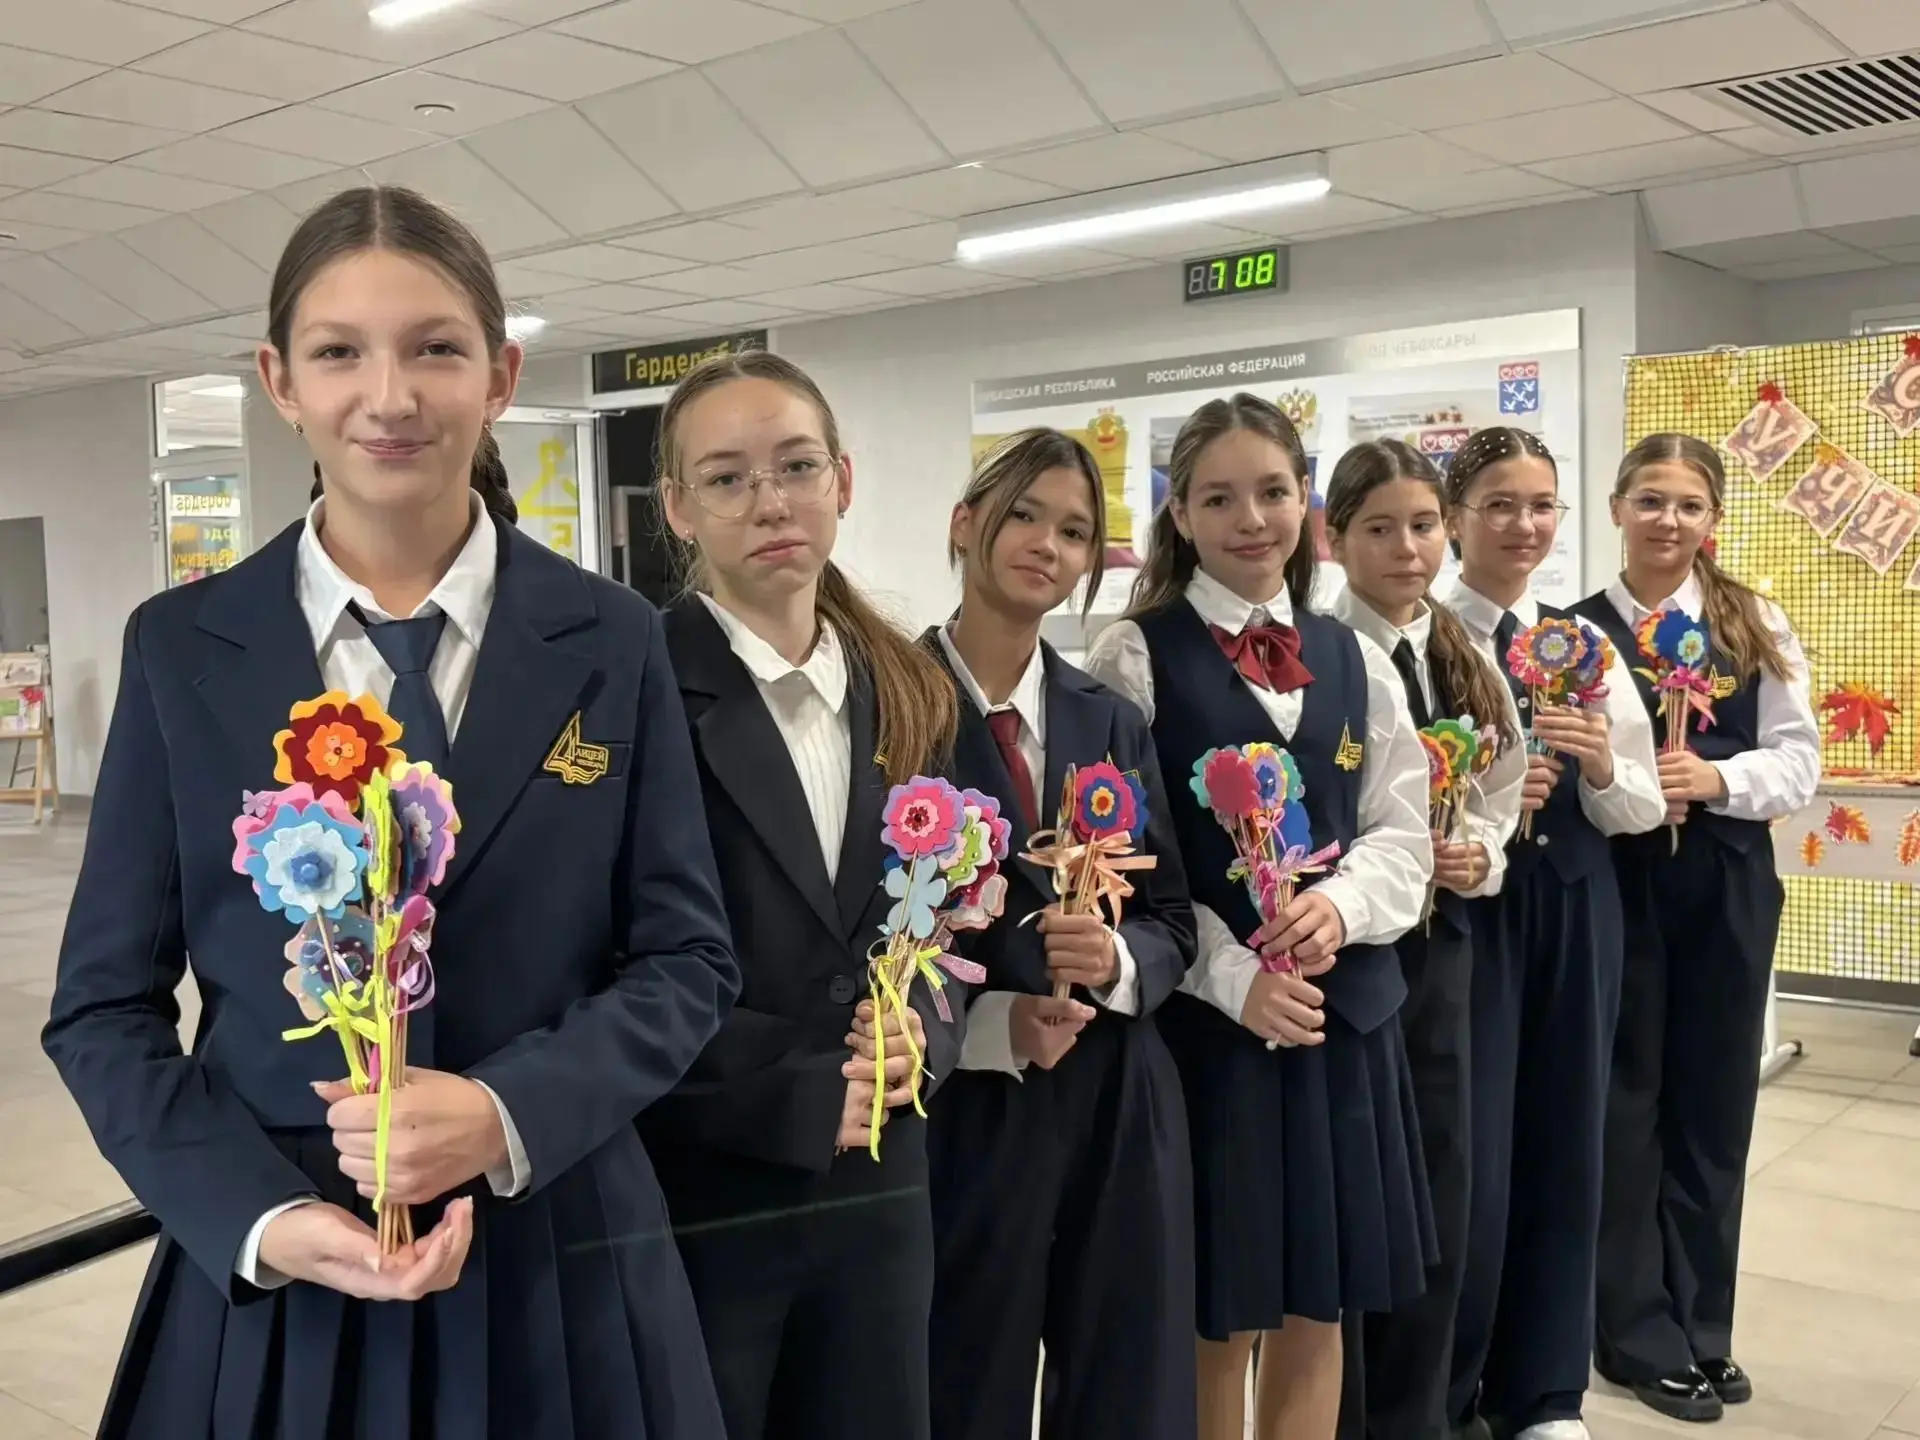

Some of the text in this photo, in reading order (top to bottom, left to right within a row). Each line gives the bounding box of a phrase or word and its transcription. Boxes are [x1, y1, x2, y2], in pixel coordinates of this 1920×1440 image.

[1146, 353, 1306, 384] РОССИЙСКАЯ ФЕДЕРАЦИЯ
[1044, 377, 1117, 397] РЕСПУБЛИКА
